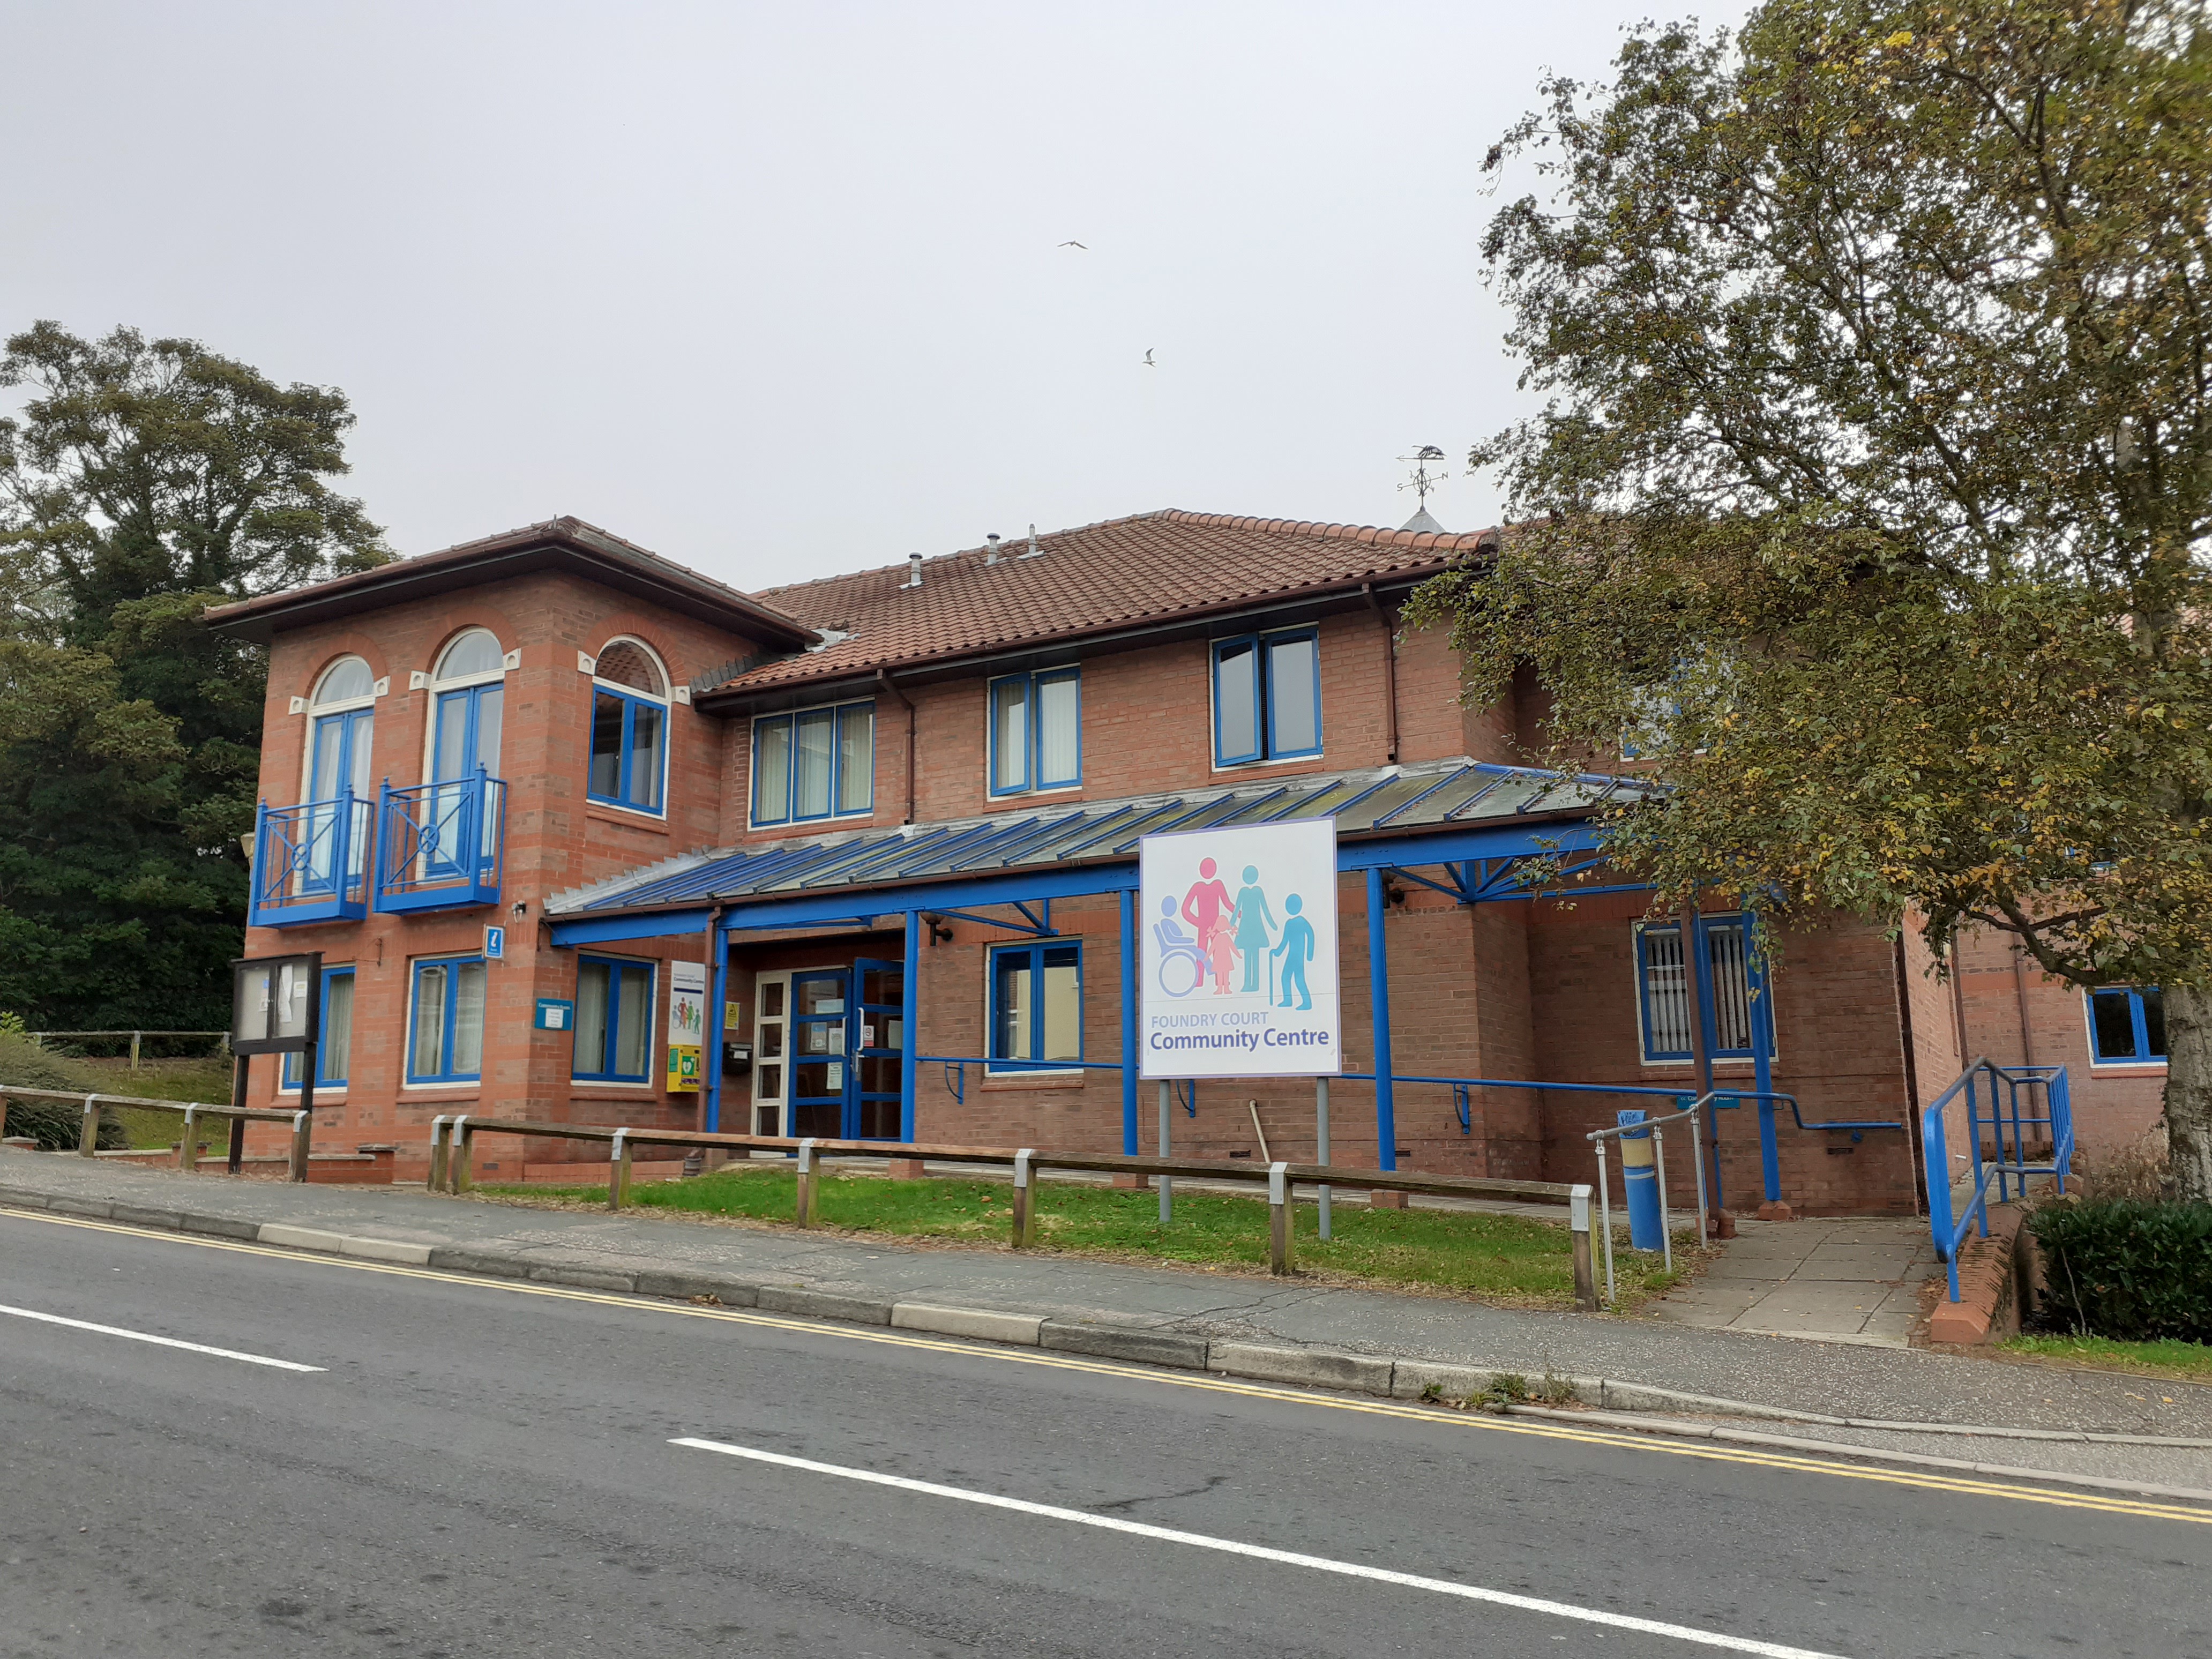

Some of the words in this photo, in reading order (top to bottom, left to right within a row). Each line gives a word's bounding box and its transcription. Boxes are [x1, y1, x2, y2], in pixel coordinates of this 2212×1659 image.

[1151, 1013, 1217, 1028] FOUNDRY
[1221, 1011, 1269, 1026] COURT
[1150, 1028, 1260, 1052] Community
[1264, 1028, 1329, 1047] Centre
